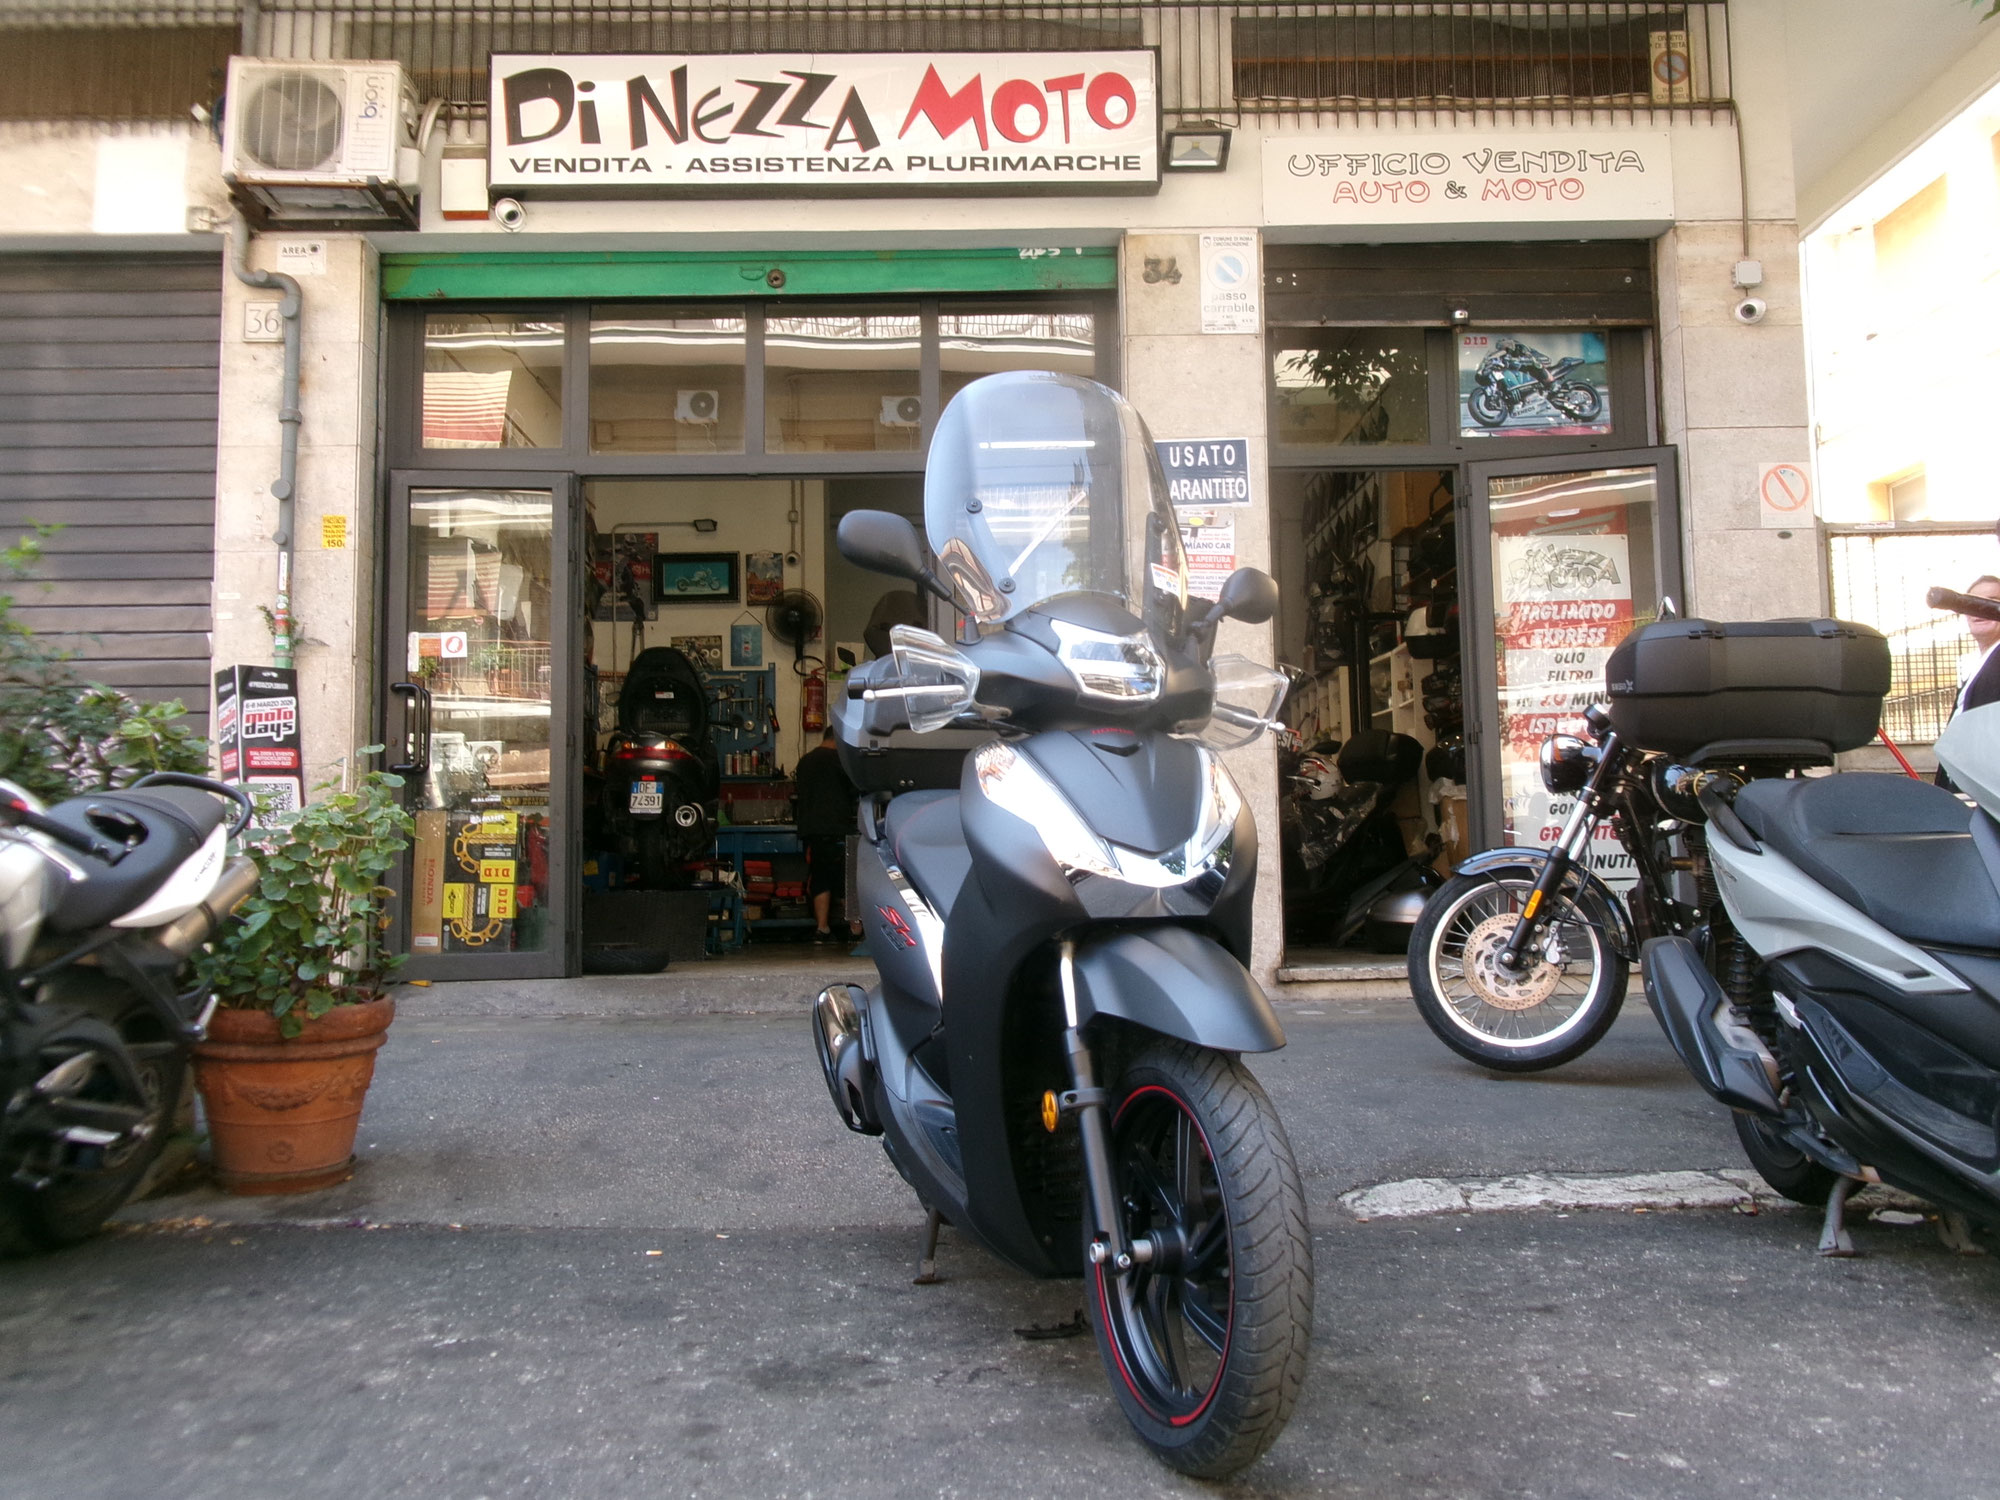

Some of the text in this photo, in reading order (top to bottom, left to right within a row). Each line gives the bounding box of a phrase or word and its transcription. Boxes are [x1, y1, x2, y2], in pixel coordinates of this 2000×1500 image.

[898, 62, 1136, 151] MOTO
[509, 157, 652, 173] VENDITA
[686, 156, 894, 172] ASSISTENZA
[907, 155, 1141, 171] PLURIMARCHE
[1288, 148, 1644, 176] UFFICIO VENDITA
[1333, 178, 1585, 203] AUTO & MOTO
[1212, 293, 1247, 303] passo
[1203, 303, 1255, 313] carrabile
[247, 309, 279, 333] 36
[1169, 444, 1236, 467] USATO
[1170, 477, 1247, 500] ARANTITO
[1197, 555, 1232, 563] APERTURA
[1520, 603, 1616, 621] TAGLIANDO
[1533, 627, 1607, 646] EXPRESS
[1554, 652, 1585, 664] OLIO
[1547, 670, 1593, 682] FILTRO
[1571, 691, 1613, 705] MINU
[245, 721, 293, 738] days
[425, 858, 436, 905] HONDA
[484, 868, 510, 878] DID
[497, 888, 508, 914] DID
